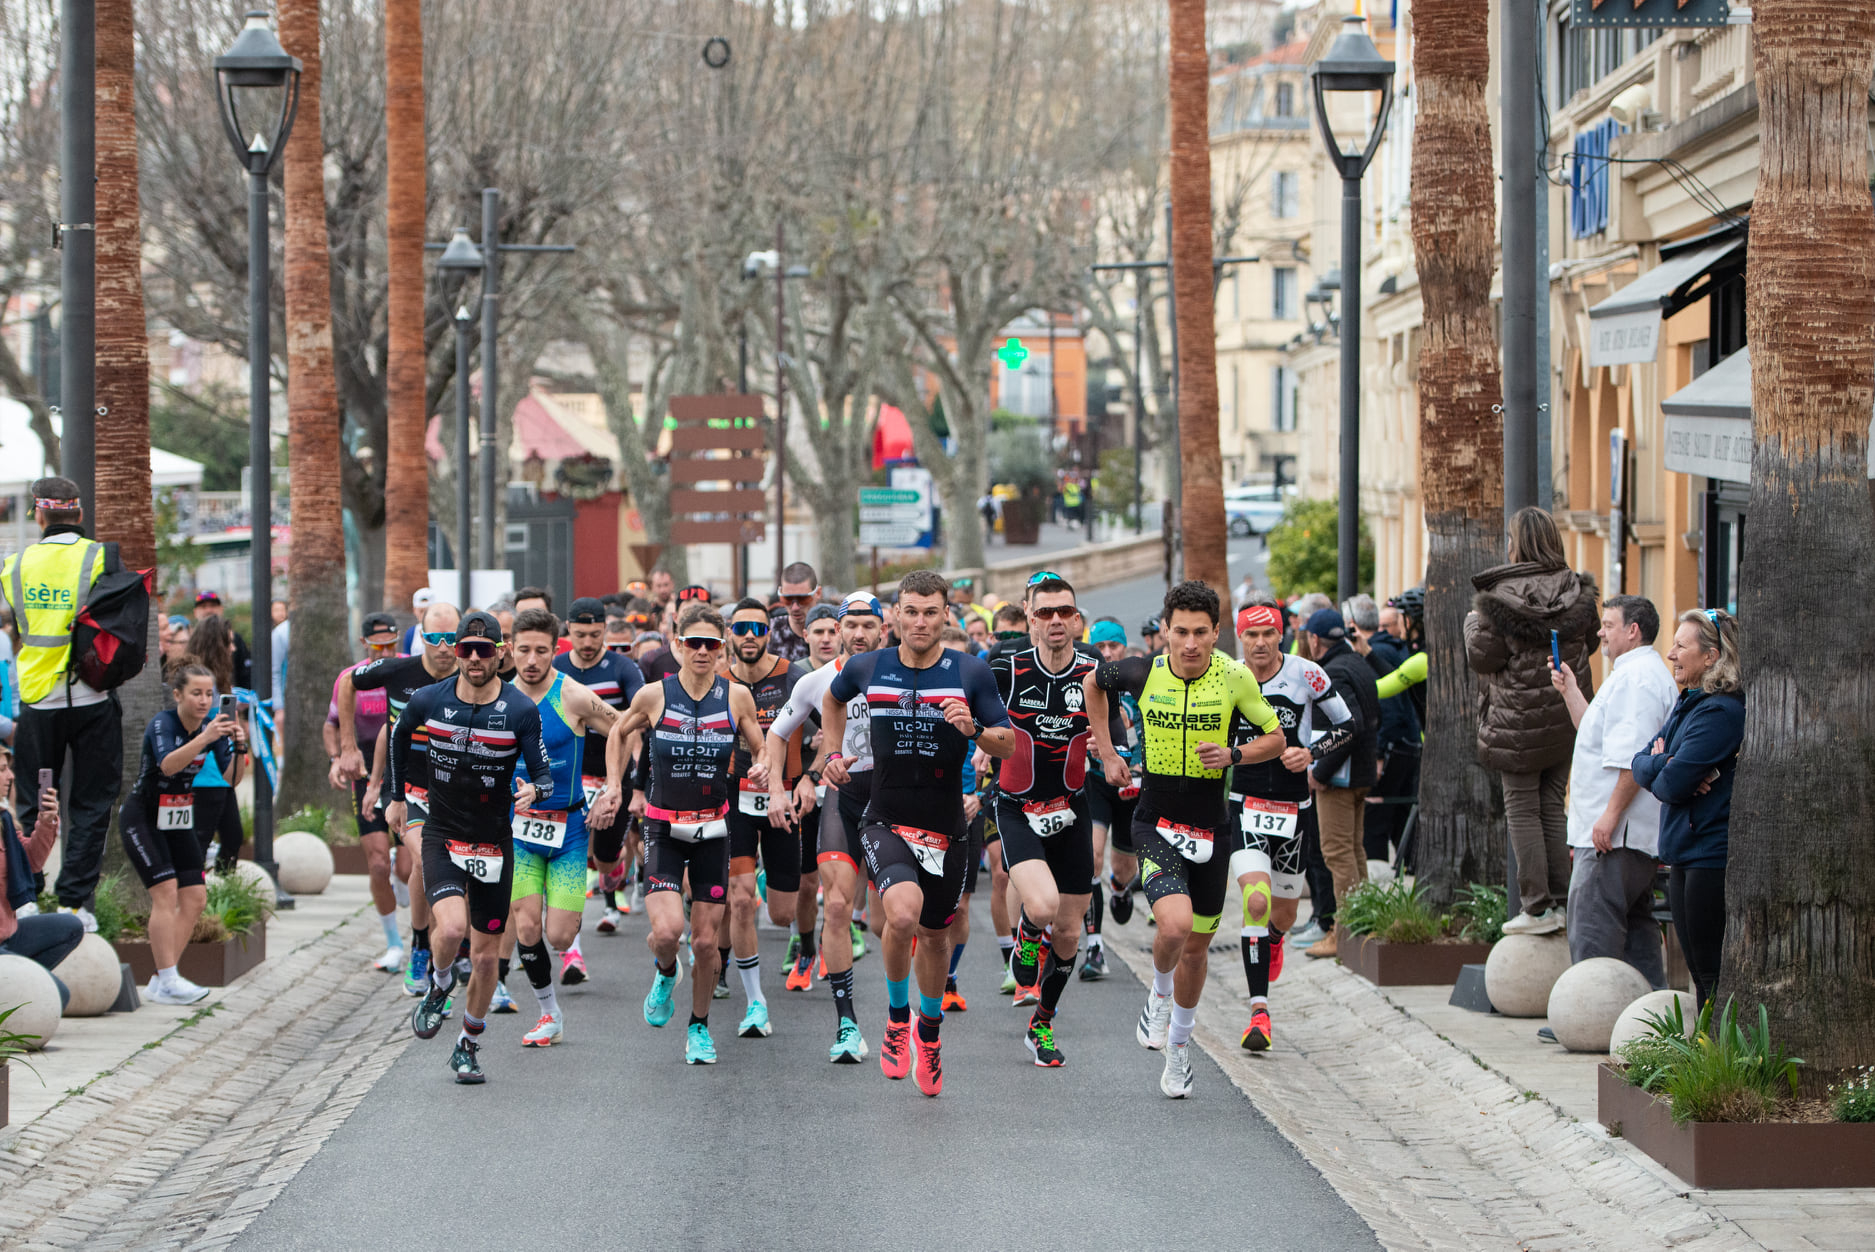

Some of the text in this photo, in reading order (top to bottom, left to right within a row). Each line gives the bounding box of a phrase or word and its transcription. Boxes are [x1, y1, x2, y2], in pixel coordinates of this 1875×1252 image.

[1019, 697, 1045, 707] BARBERA
[1146, 709, 1221, 723] ANTIBES
[1146, 719, 1221, 731] TRIATHLON
[167, 809, 189, 825] 170
[1039, 815, 1063, 834] 36
[1253, 813, 1287, 831] 137
[522, 820, 556, 841] 138
[693, 826, 704, 840] 4
[1172, 833, 1197, 855] 24
[464, 858, 487, 878] 68
